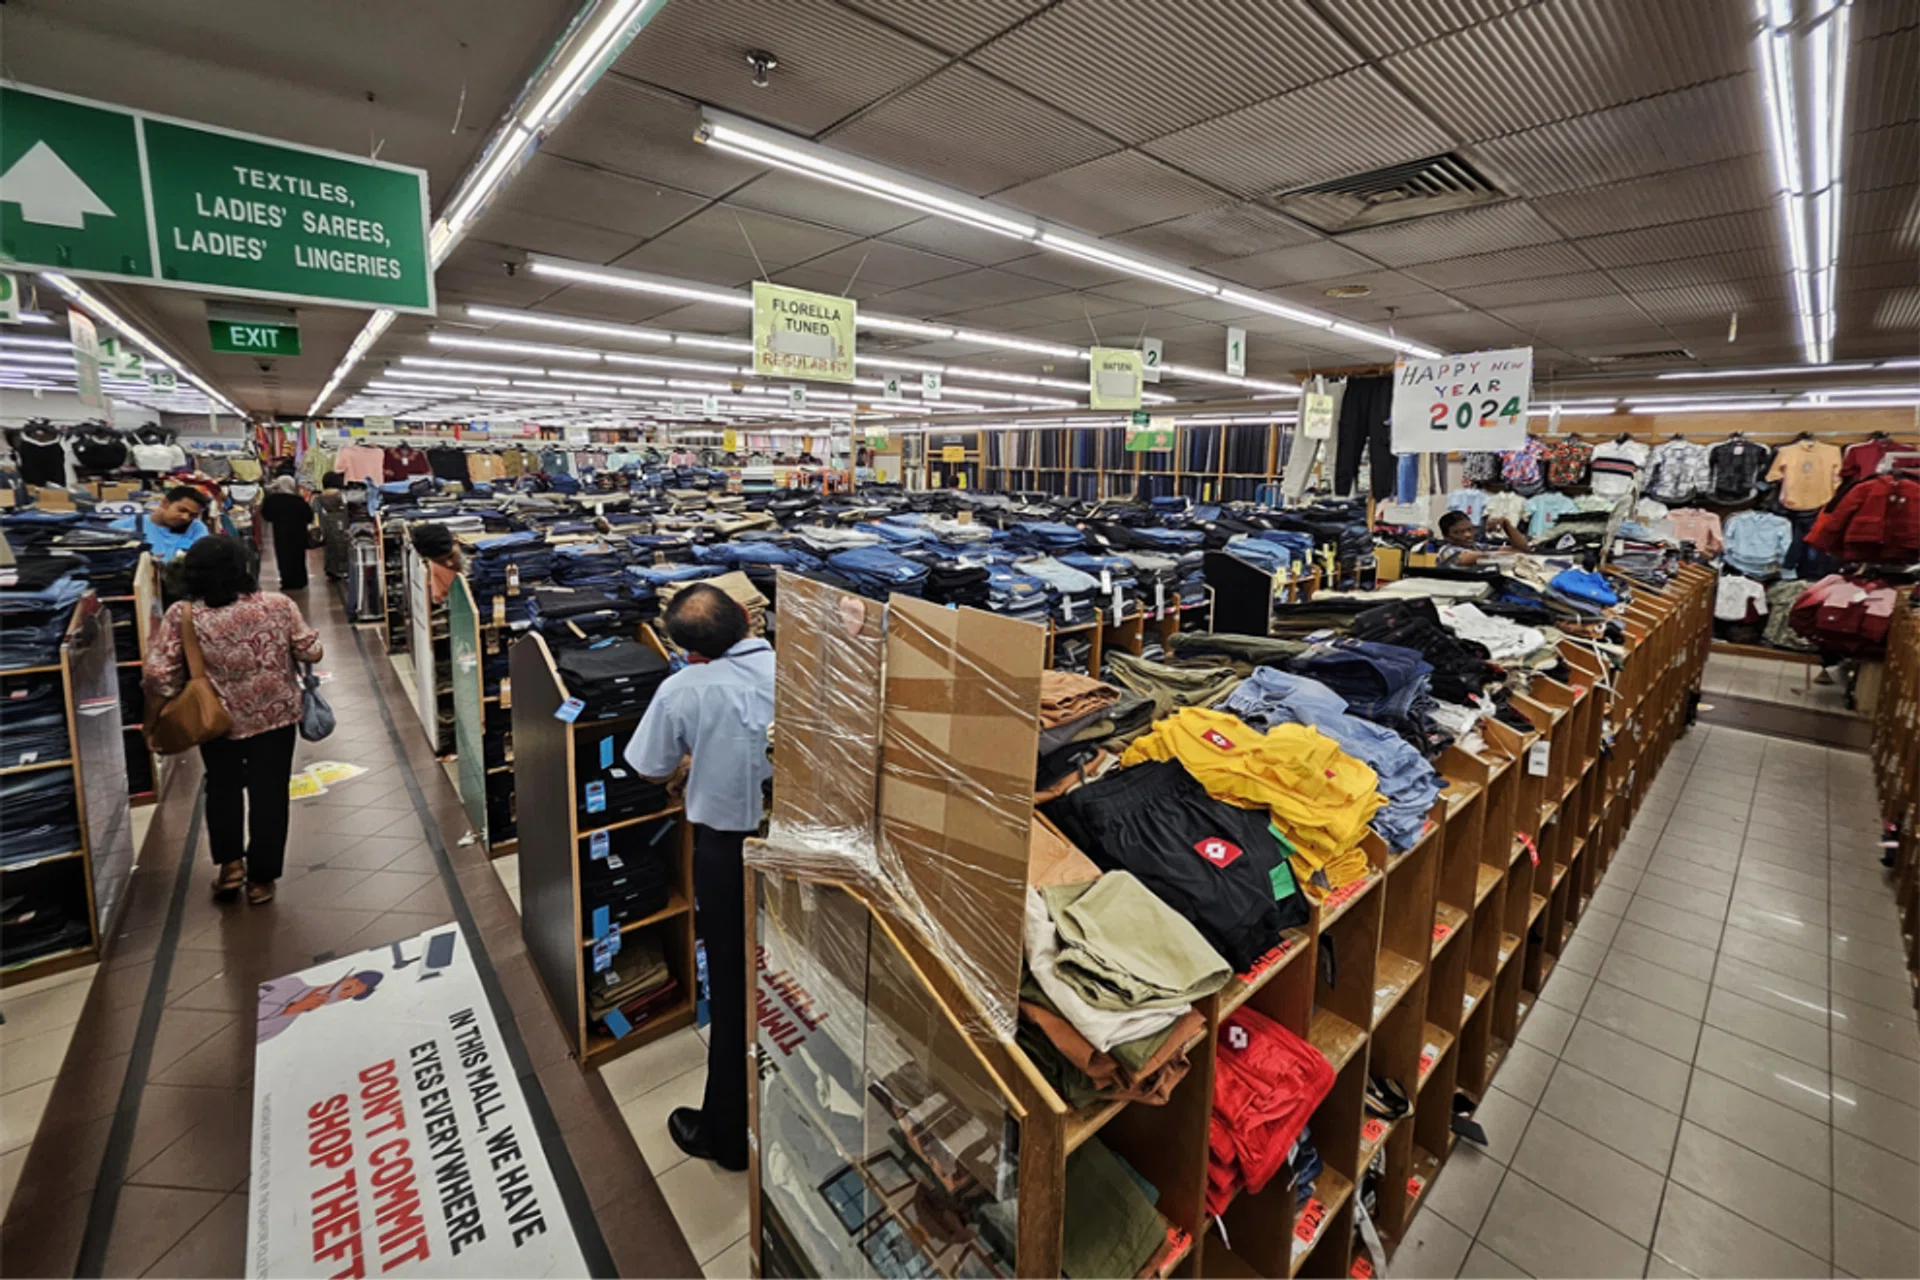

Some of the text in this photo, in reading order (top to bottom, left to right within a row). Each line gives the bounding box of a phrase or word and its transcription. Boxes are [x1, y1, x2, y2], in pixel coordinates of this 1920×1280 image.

[233, 165, 355, 208] TEXTILES,
[302, 210, 391, 248] SAREES,
[294, 245, 401, 280] LINGERIES
[772, 298, 841, 321] FLORELLA
[230, 326, 279, 348] EXIT
[785, 318, 830, 336] TUNED
[1147, 350, 1158, 367] 2
[1232, 341, 1240, 361] 1
[150, 373, 175, 387] 13
[1400, 360, 1524, 386] HAPPY NEW
[793, 390, 802, 401] 5
[888, 380, 898, 392] 4
[1434, 379, 1501, 398] YEAR
[1430, 396, 1521, 430] 2024
[307, 1093, 354, 1169] SHOP
[448, 1007, 547, 1248] IN THIS MALL, WE HAVE
[409, 1040, 486, 1257] EYES EVERYWHERE
[358, 1058, 430, 1274] DON'T COMMIT
